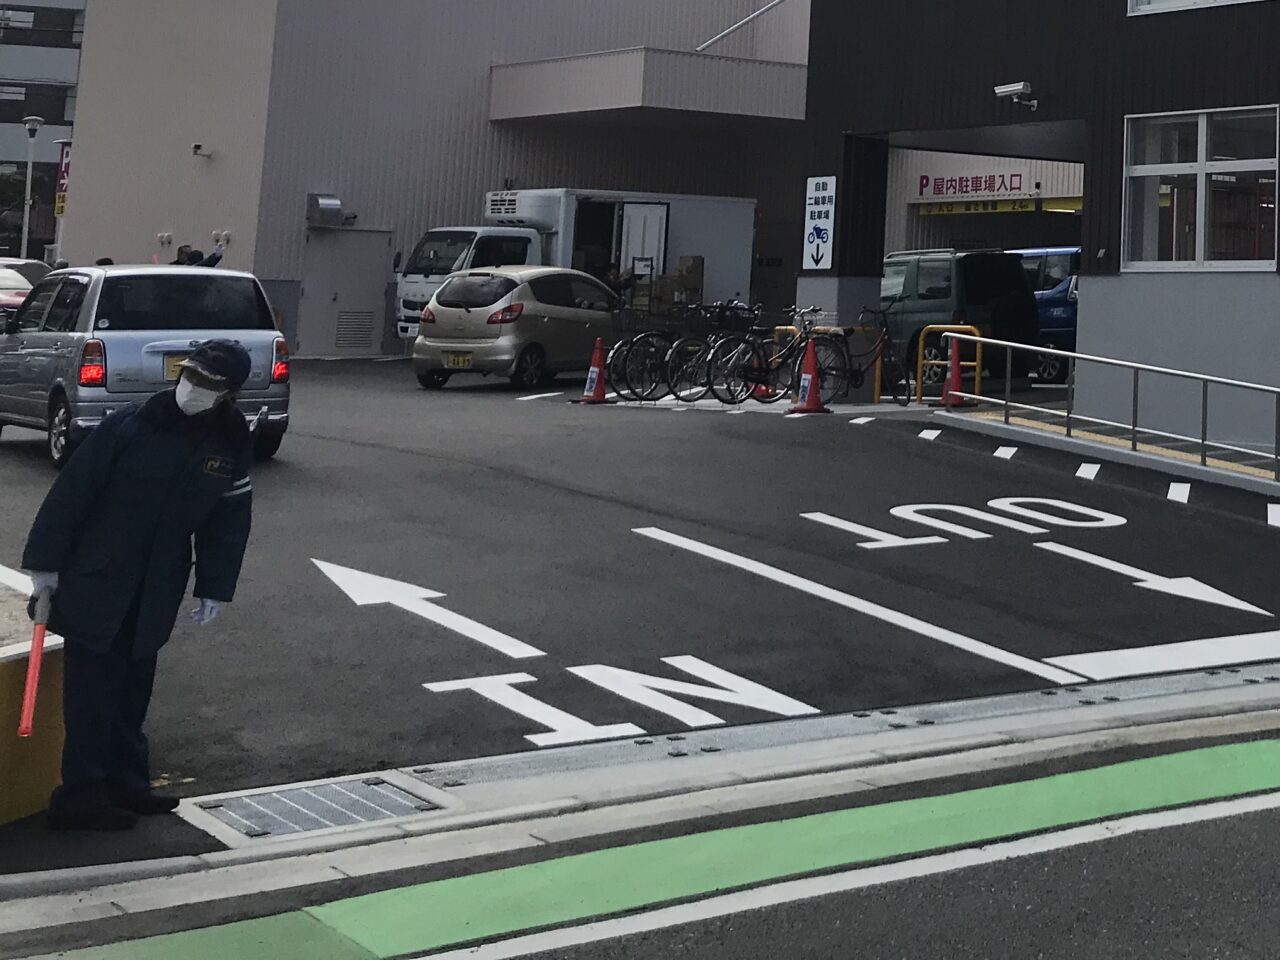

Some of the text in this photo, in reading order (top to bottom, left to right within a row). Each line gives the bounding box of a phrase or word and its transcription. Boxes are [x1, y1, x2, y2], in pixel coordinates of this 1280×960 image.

[815, 181, 828, 192] 自動
[919, 174, 1022, 196] P 屋内駐車場入口
[807, 195, 834, 206] 二輪車用
[809, 210, 830, 220] 駐車場
[800, 497, 1127, 549] OUT
[422, 655, 821, 746] IN
